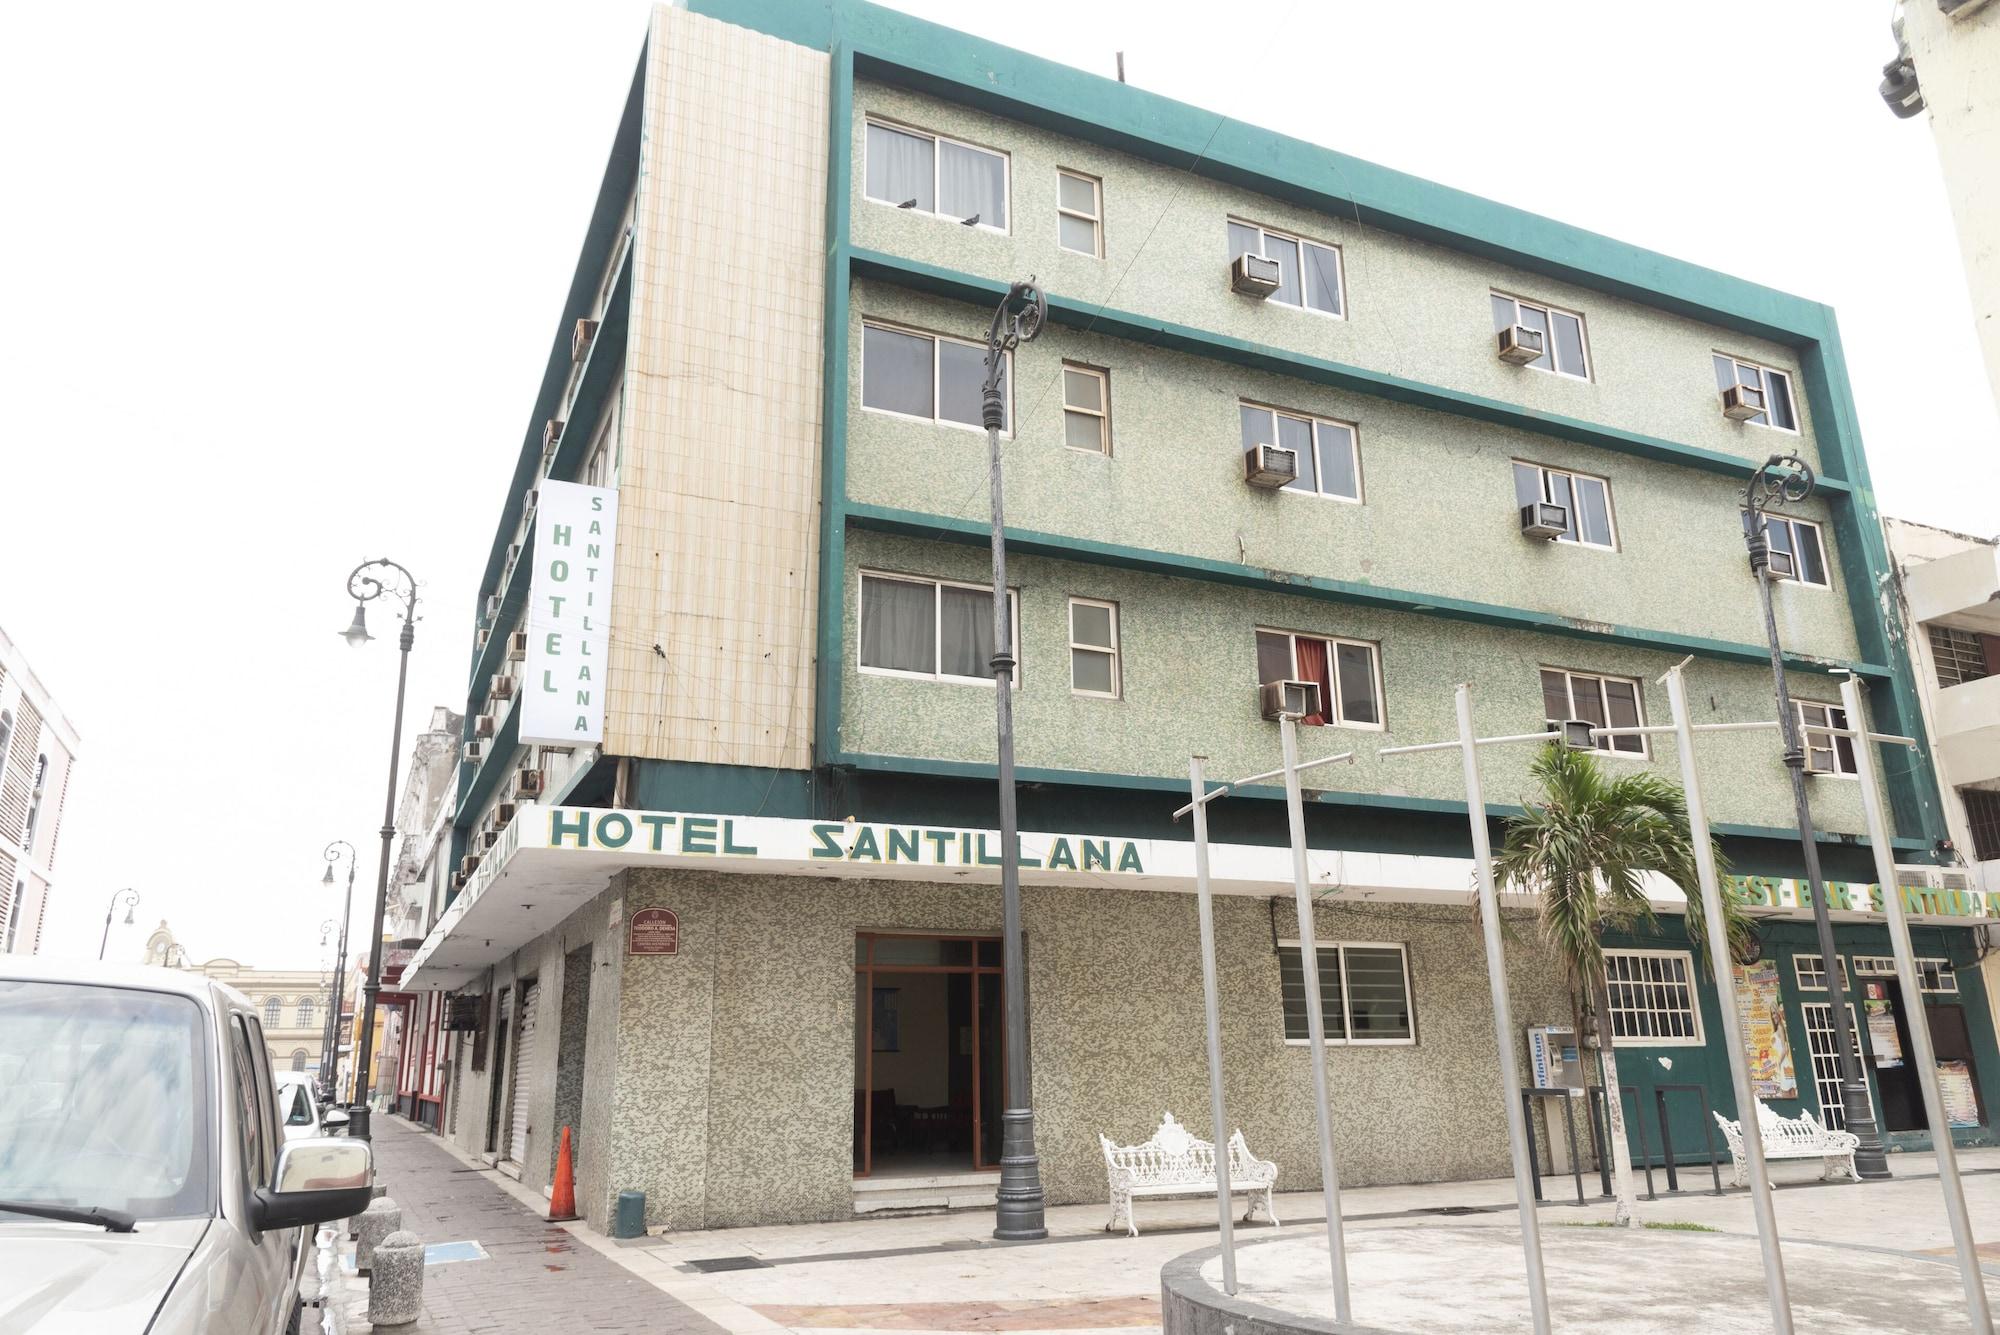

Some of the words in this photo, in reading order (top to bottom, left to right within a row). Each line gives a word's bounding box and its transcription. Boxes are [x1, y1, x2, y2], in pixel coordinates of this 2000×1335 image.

[543, 523, 572, 694] HOTEL
[574, 496, 603, 732] SANTILLANA
[549, 809, 757, 857] HOTEL
[810, 824, 1144, 873] SANTILLANA
[1533, 1032, 1546, 1087] nfinitum
